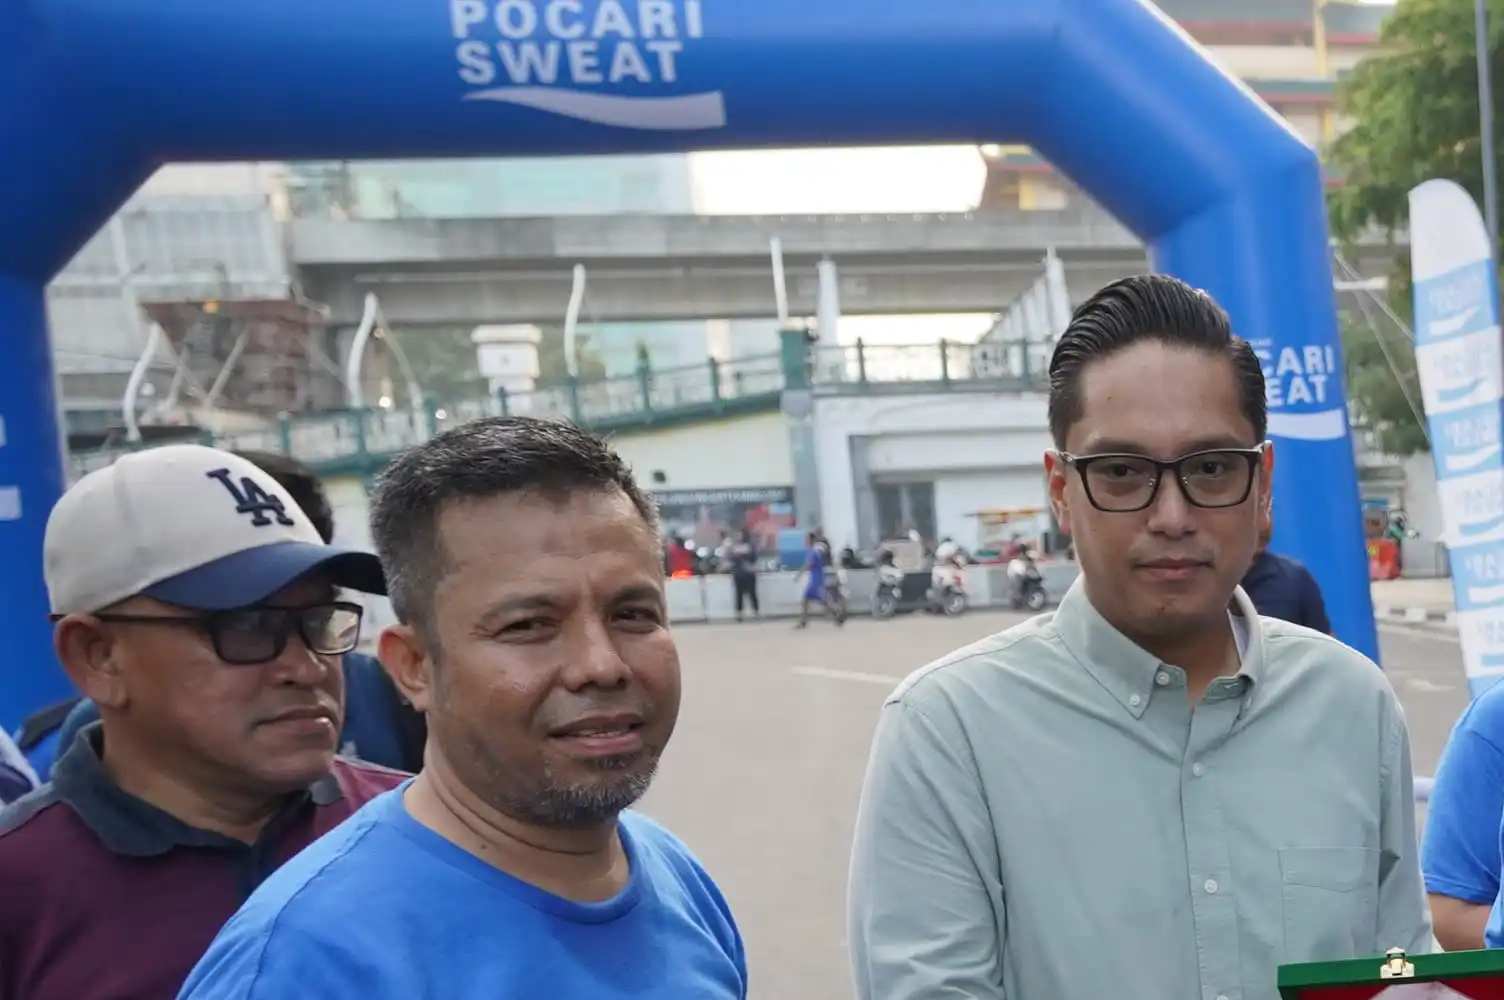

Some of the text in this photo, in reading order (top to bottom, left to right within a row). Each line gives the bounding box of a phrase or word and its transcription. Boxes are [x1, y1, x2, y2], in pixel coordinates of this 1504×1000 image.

[451, 0, 704, 39] POCARI
[456, 40, 684, 84] SWEAT
[1250, 344, 1335, 378] CARI
[1264, 374, 1327, 407] EAT
[205, 467, 295, 527] LA
